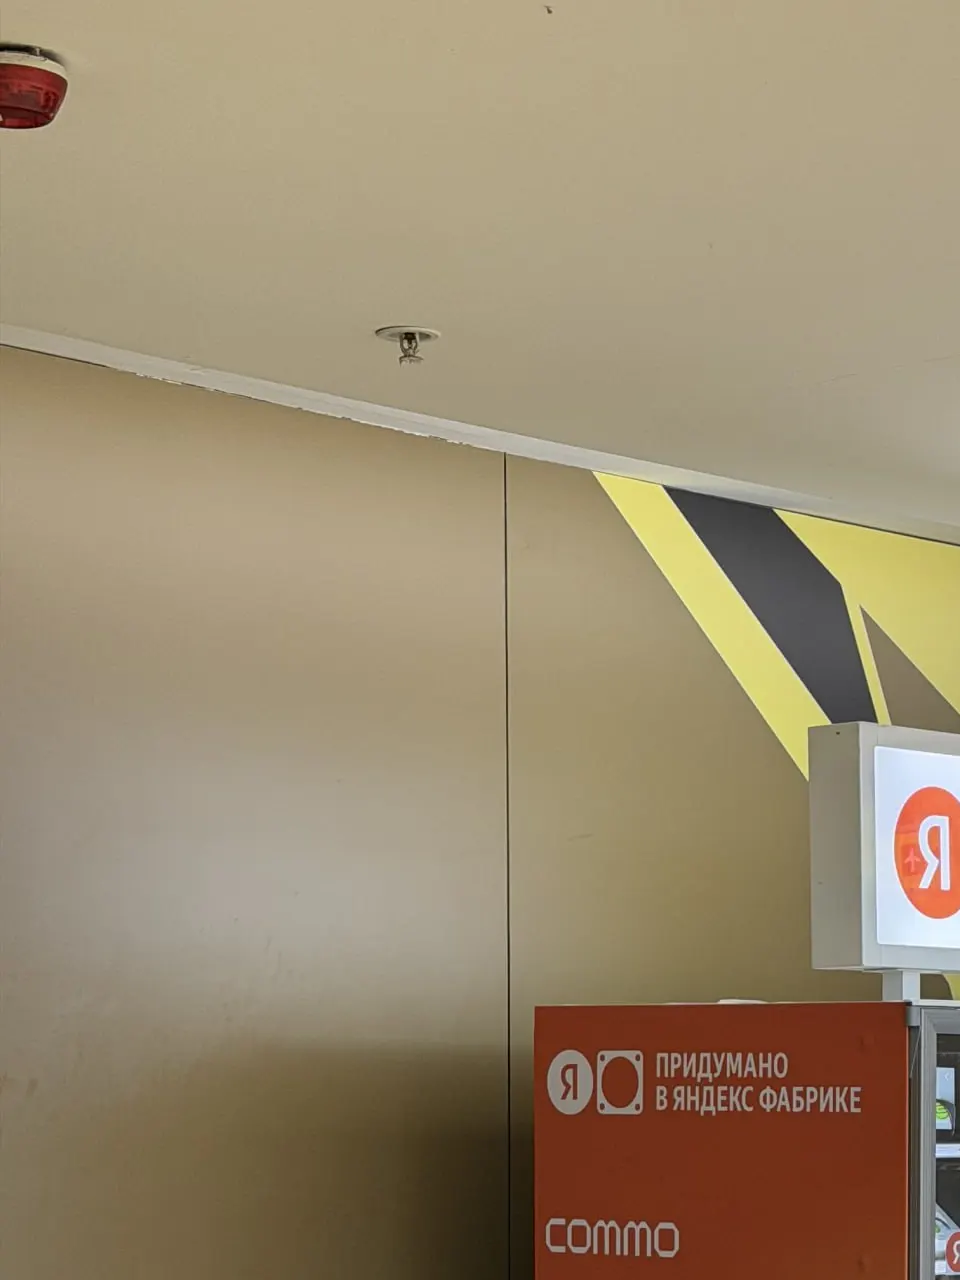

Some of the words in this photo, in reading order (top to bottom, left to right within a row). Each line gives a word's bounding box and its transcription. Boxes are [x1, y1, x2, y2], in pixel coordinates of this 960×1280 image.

[918, 815, 951, 891] Я
[560, 1063, 579, 1101] Я
[655, 1052, 789, 1083] ПРИДУМАНО
[655, 1085, 668, 1112] В
[672, 1085, 754, 1117] ЯНДЕКС
[758, 1086, 862, 1114] ФАБРИКЕ
